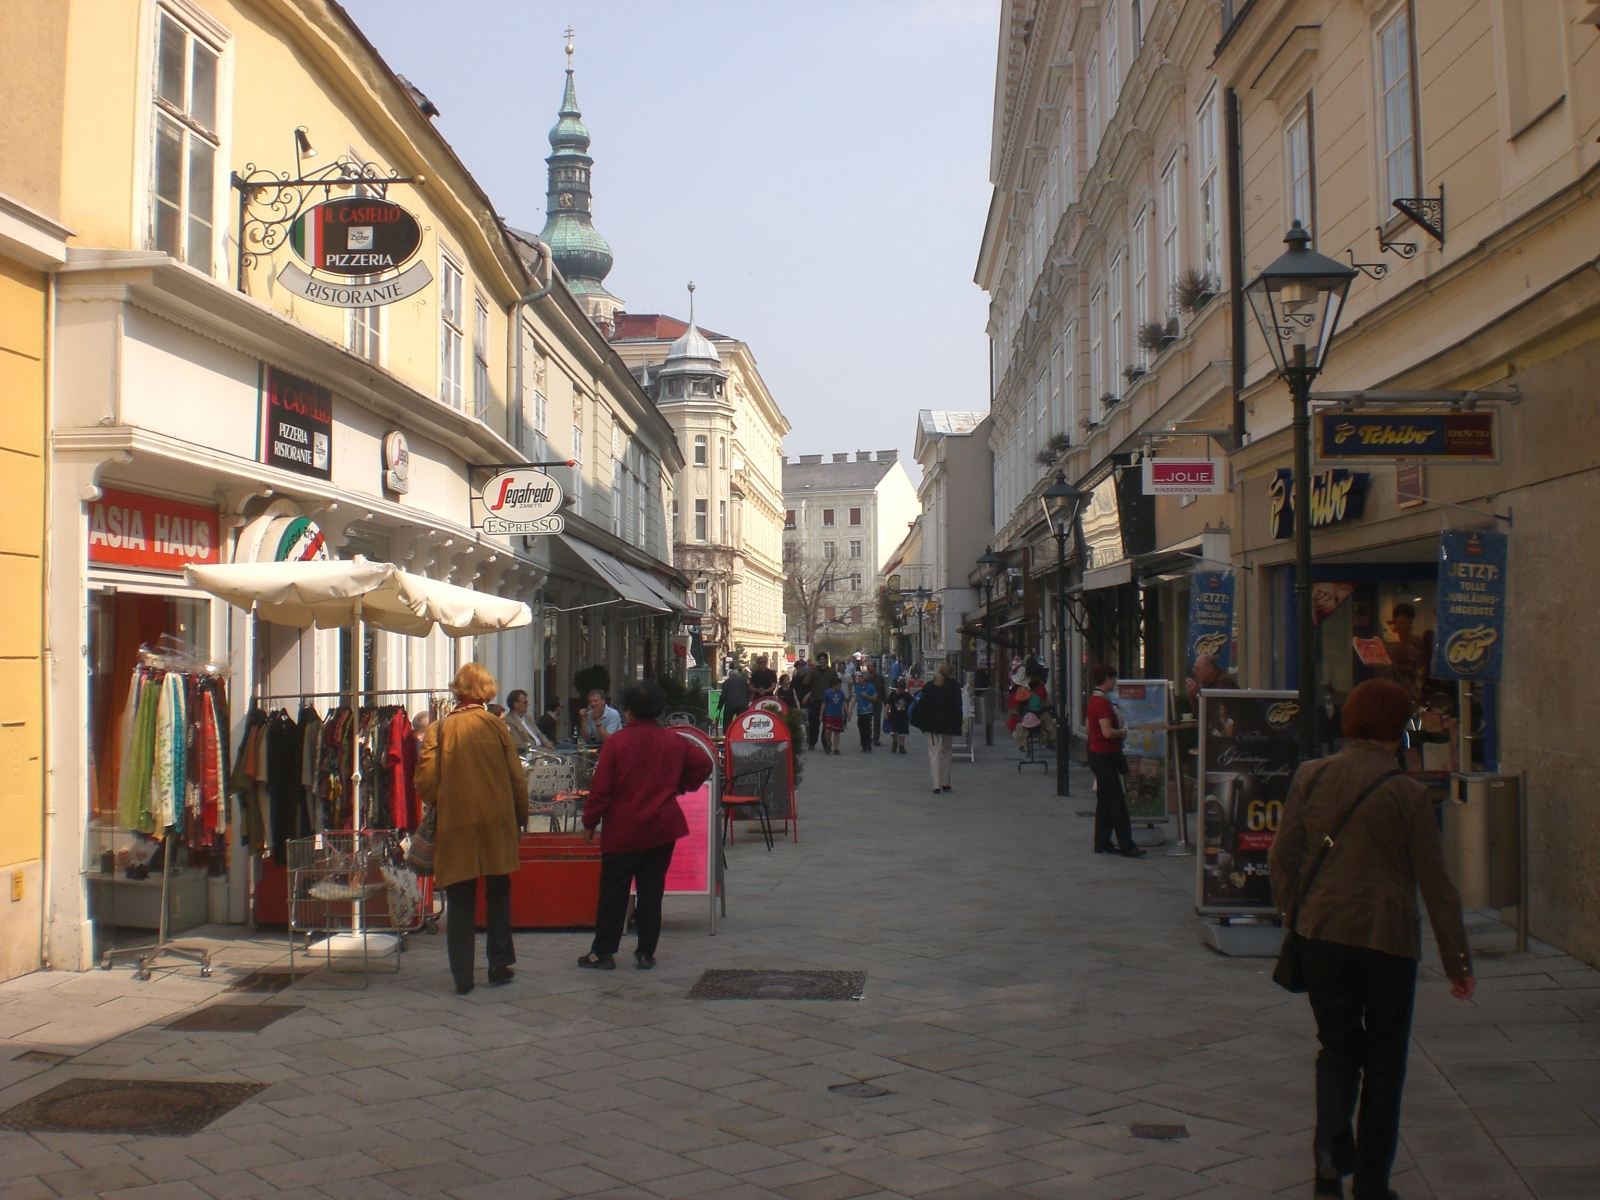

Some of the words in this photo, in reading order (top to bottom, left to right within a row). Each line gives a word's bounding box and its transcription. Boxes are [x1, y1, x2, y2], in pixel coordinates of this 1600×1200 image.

[325, 207, 335, 222] IL
[339, 206, 400, 223] CASTELLO
[350, 233, 370, 243] Zipfer
[326, 253, 393, 266] PIZZERIA
[305, 282, 403, 304] RISTORANTE
[279, 421, 308, 445] PIZZERIA
[1357, 424, 1436, 445] Tchibo
[273, 440, 312, 465] RISTORANTE
[490, 477, 554, 511] Segafredo
[89, 502, 146, 552] ASIA
[153, 513, 210, 559] HAUS
[487, 517, 560, 533] ESPRESSO
[1447, 563, 1499, 579] JETZT:
[1460, 581, 1487, 592] TOLLE
[1449, 605, 1495, 617] ANGEBOTE
